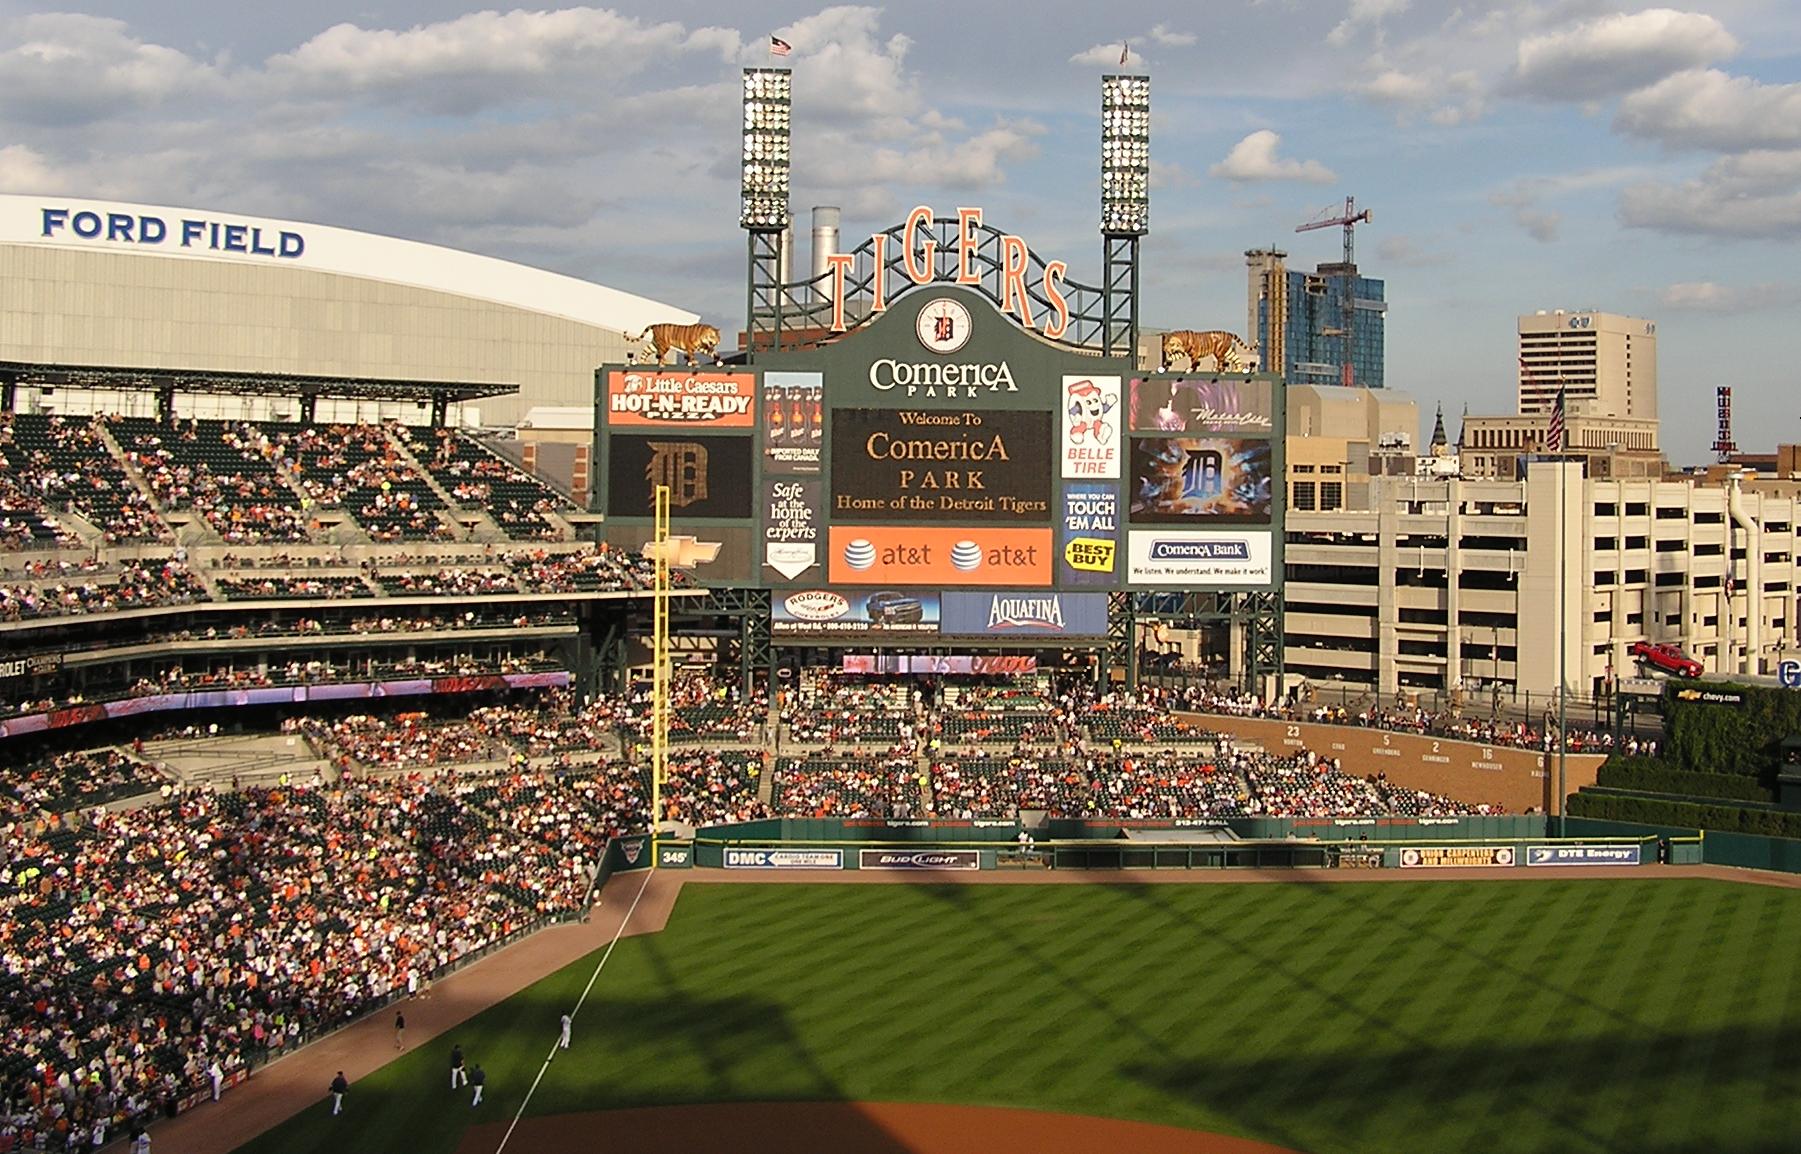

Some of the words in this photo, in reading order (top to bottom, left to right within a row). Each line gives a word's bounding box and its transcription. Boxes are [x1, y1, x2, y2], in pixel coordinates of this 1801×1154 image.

[41, 208, 167, 244] FORD
[181, 218, 305, 258] FIELD
[827, 205, 1068, 340] TIGERS
[645, 377, 682, 393] Little
[685, 378, 738, 394] Caesars
[908, 386, 977, 397] PARK
[611, 394, 751, 414] HOT-N-READY
[646, 411, 716, 420] PIZZA
[900, 412, 961, 426] Welcome
[963, 413, 982, 426] To
[1068, 448, 1114, 460] BELLE
[1073, 462, 1107, 474] TIRE
[900, 471, 985, 489] PARK
[772, 482, 804, 500] Safe
[789, 499, 805, 508] the
[837, 496, 886, 510] Home
[890, 496, 907, 510] of
[910, 496, 935, 510] the
[940, 496, 994, 511] Detroit
[998, 496, 1047, 513] Tigers
[1067, 501, 1115, 515] TOUCH
[771, 503, 812, 520] home
[779, 519, 791, 528] of
[791, 519, 807, 528] the
[1091, 516, 1115, 531] ALL
[766, 526, 817, 542] experts
[882, 544, 931, 565] at&t
[988, 545, 1037, 566] at&t
[1072, 543, 1113, 556] BEST
[1214, 544, 1242, 555] Bank
[1073, 554, 1108, 566] BUY
[1225, 567, 1241, 575] make
[790, 593, 843, 605] RODGERS
[987, 594, 1063, 627] AQUAFINA
[1703, 693, 1740, 703] chevy.com
[1287, 726, 1300, 737] 23
[1383, 735, 1390, 745] 5
[1432, 741, 1439, 752] 2
[1482, 749, 1493, 760] 16
[1537, 757, 1544, 767] 6
[729, 852, 766, 865] DMC
[1558, 849, 1583, 857] DTE
[1587, 849, 1630, 858] Energy
[880, 856, 910, 864] BUD
[917, 856, 957, 864] LIGHT
